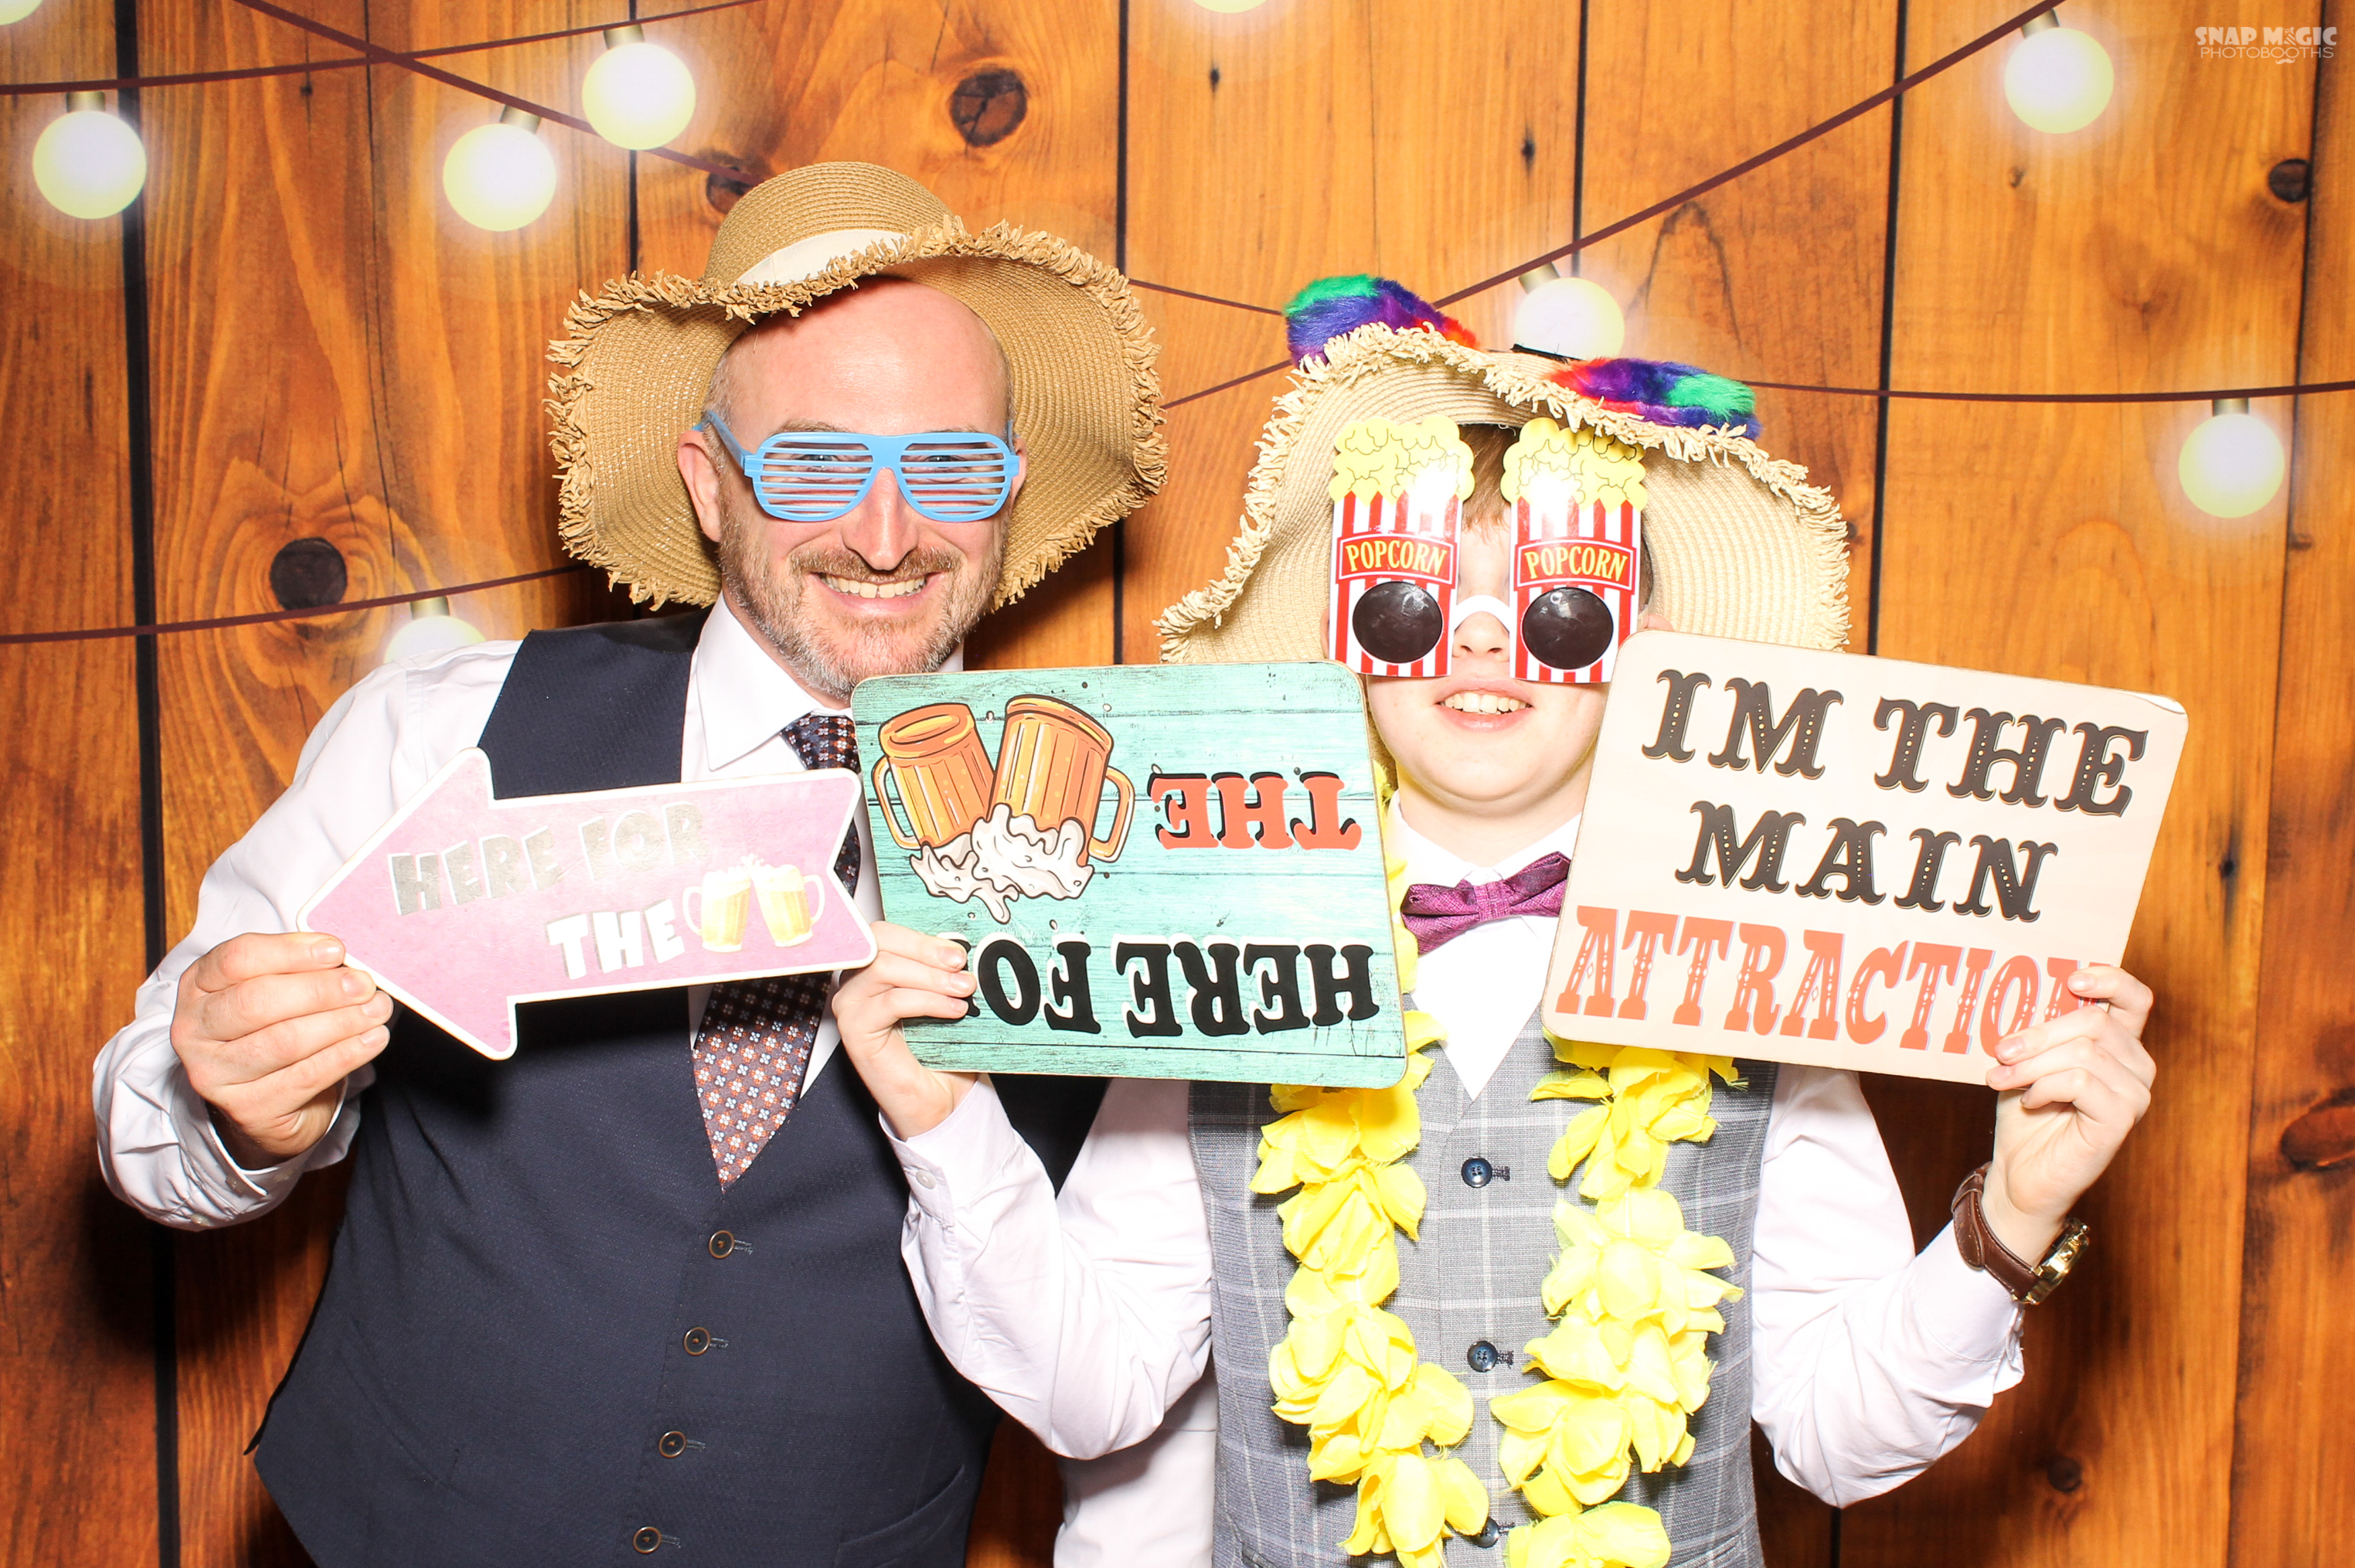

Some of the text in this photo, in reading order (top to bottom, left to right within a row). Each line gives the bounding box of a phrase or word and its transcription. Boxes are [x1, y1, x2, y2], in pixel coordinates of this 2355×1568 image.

[1346, 539, 1448, 576] POPCORN
[1524, 546, 1628, 582] POPCORN
[1642, 668, 2149, 818] IM THE
[1148, 772, 1362, 850] THE
[388, 801, 709, 916] HERE FOR
[1675, 801, 2058, 923] MAIN
[545, 898, 686, 980] THE
[941, 932, 1380, 1038] HERE FO
